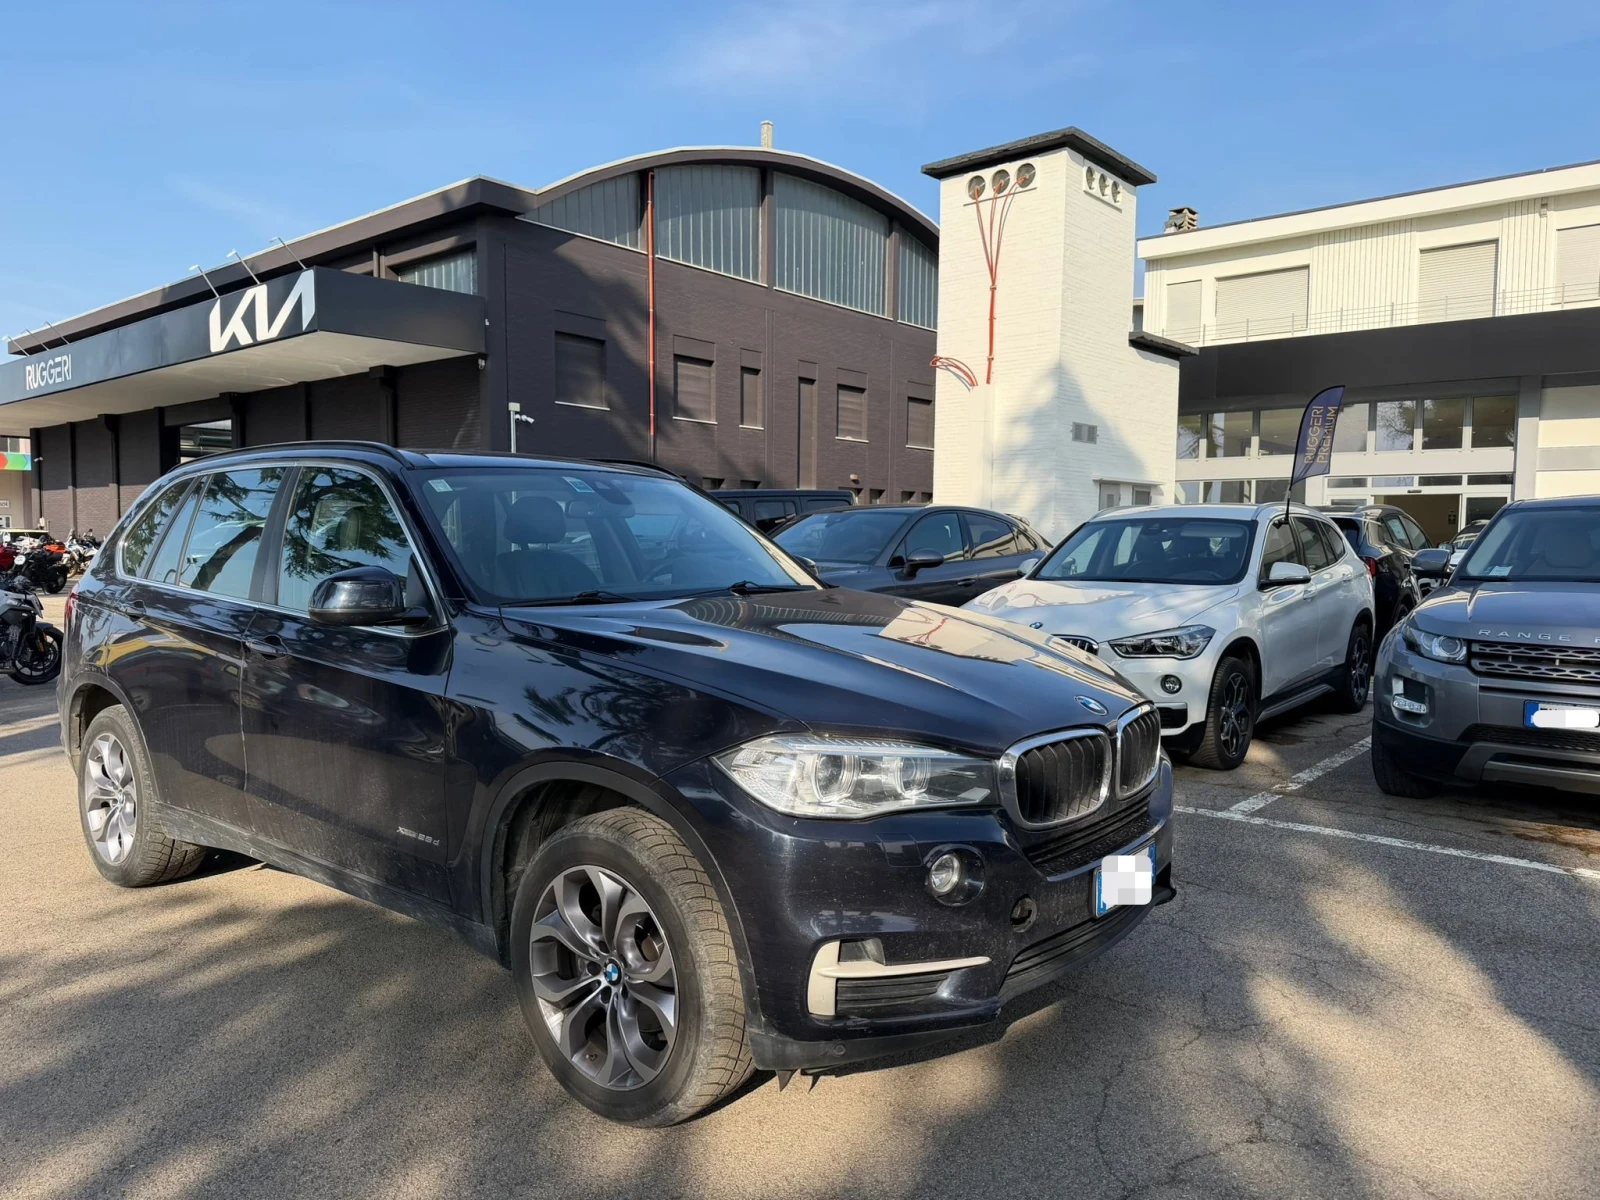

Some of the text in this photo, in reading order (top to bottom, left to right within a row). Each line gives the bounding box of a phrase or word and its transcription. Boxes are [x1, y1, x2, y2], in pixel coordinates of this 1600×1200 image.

[209, 269, 315, 353] KIA
[25, 353, 72, 390] RUGGERI
[1304, 405, 1324, 464] RUGGERI
[1316, 406, 1339, 464] PREMIUM
[1478, 629, 1572, 642] RANGE
